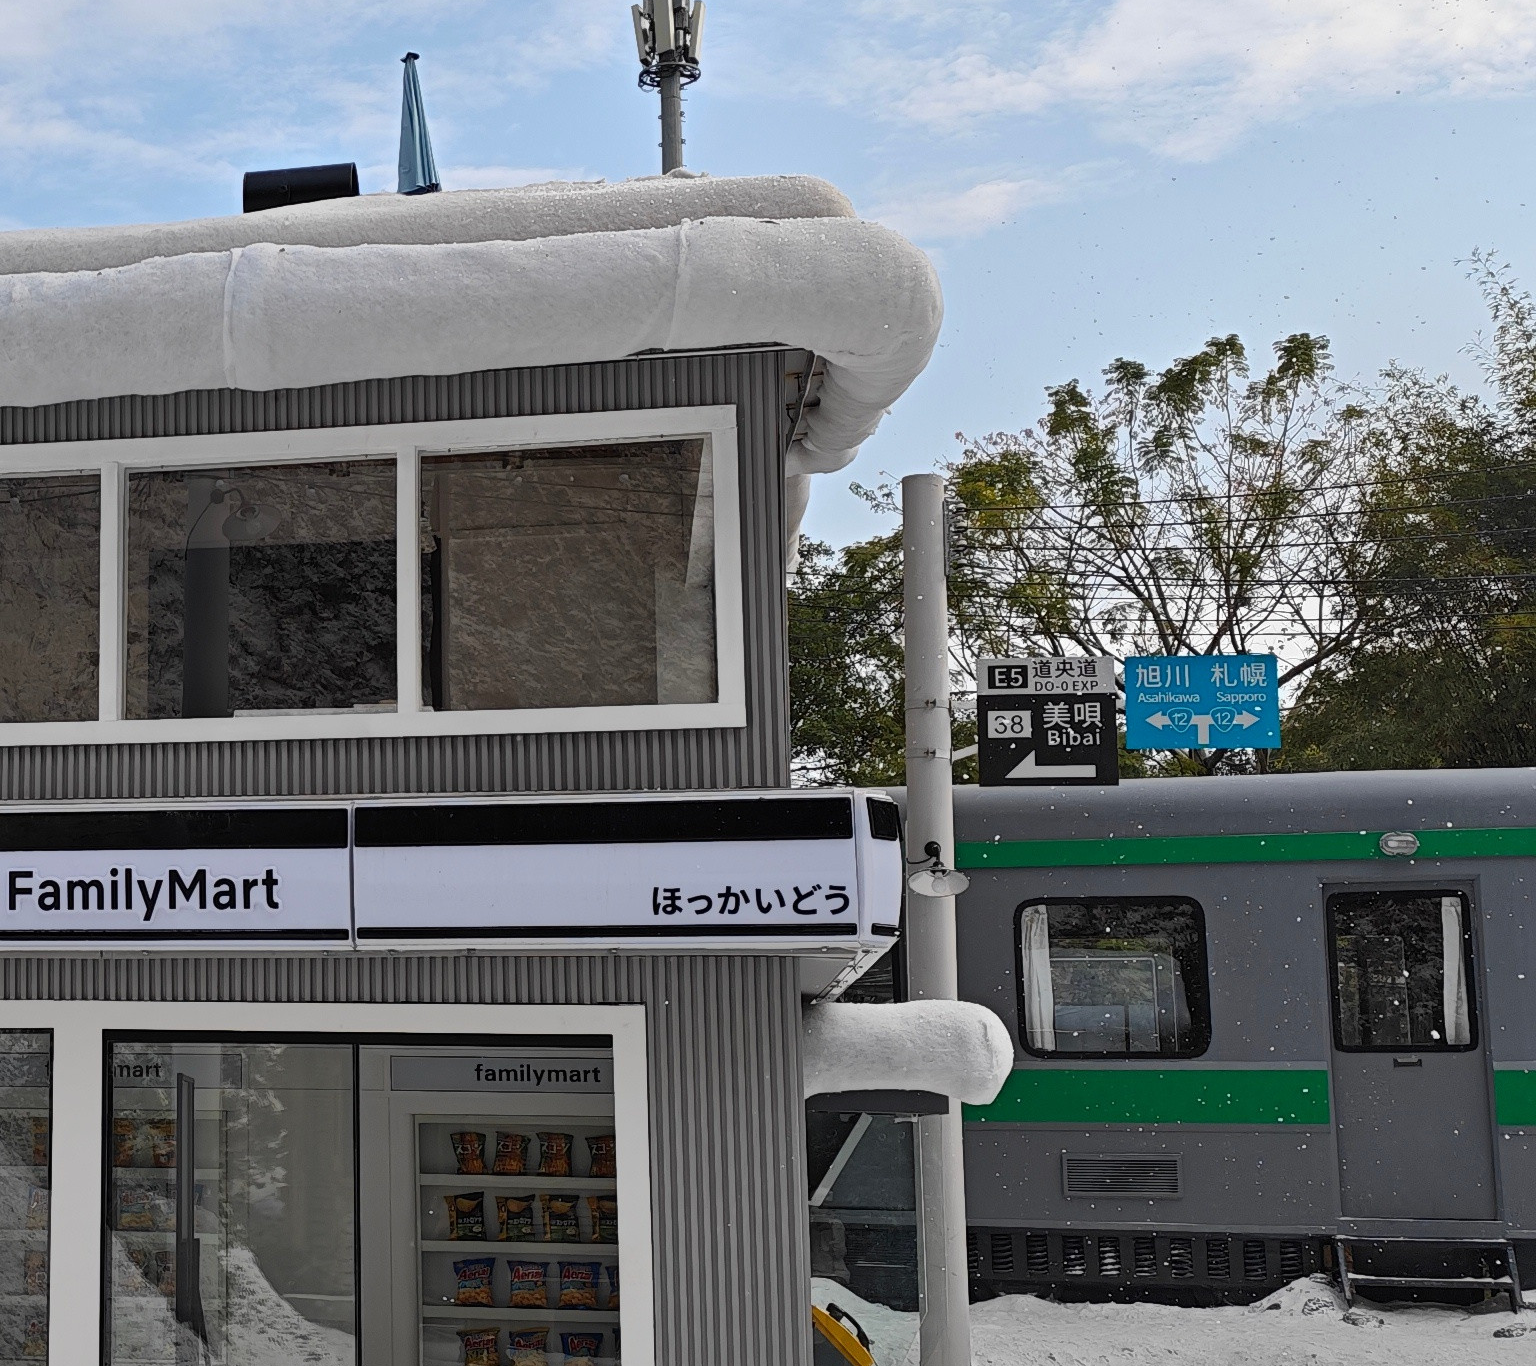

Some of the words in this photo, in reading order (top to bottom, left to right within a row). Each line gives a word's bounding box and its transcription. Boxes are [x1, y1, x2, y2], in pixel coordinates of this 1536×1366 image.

[995, 668, 1023, 687] E5
[1032, 659, 1098, 678] 道央道
[1136, 664, 1190, 688] 旭川
[1211, 662, 1267, 688] 札幌
[1072, 680, 1099, 691] EXP
[1137, 691, 1201, 703] Asahikawa
[1216, 691, 1267, 705] Sapporo
[1042, 701, 1103, 728] 美唄
[1172, 712, 1188, 726] 12
[1215, 712, 1231, 725] 12
[994, 715, 1024, 734] 38
[1047, 728, 1101, 746] Bibai
[8, 867, 280, 922] FamilyMart
[652, 884, 850, 916] ほっかいどう
[474, 1063, 601, 1086] familymart
